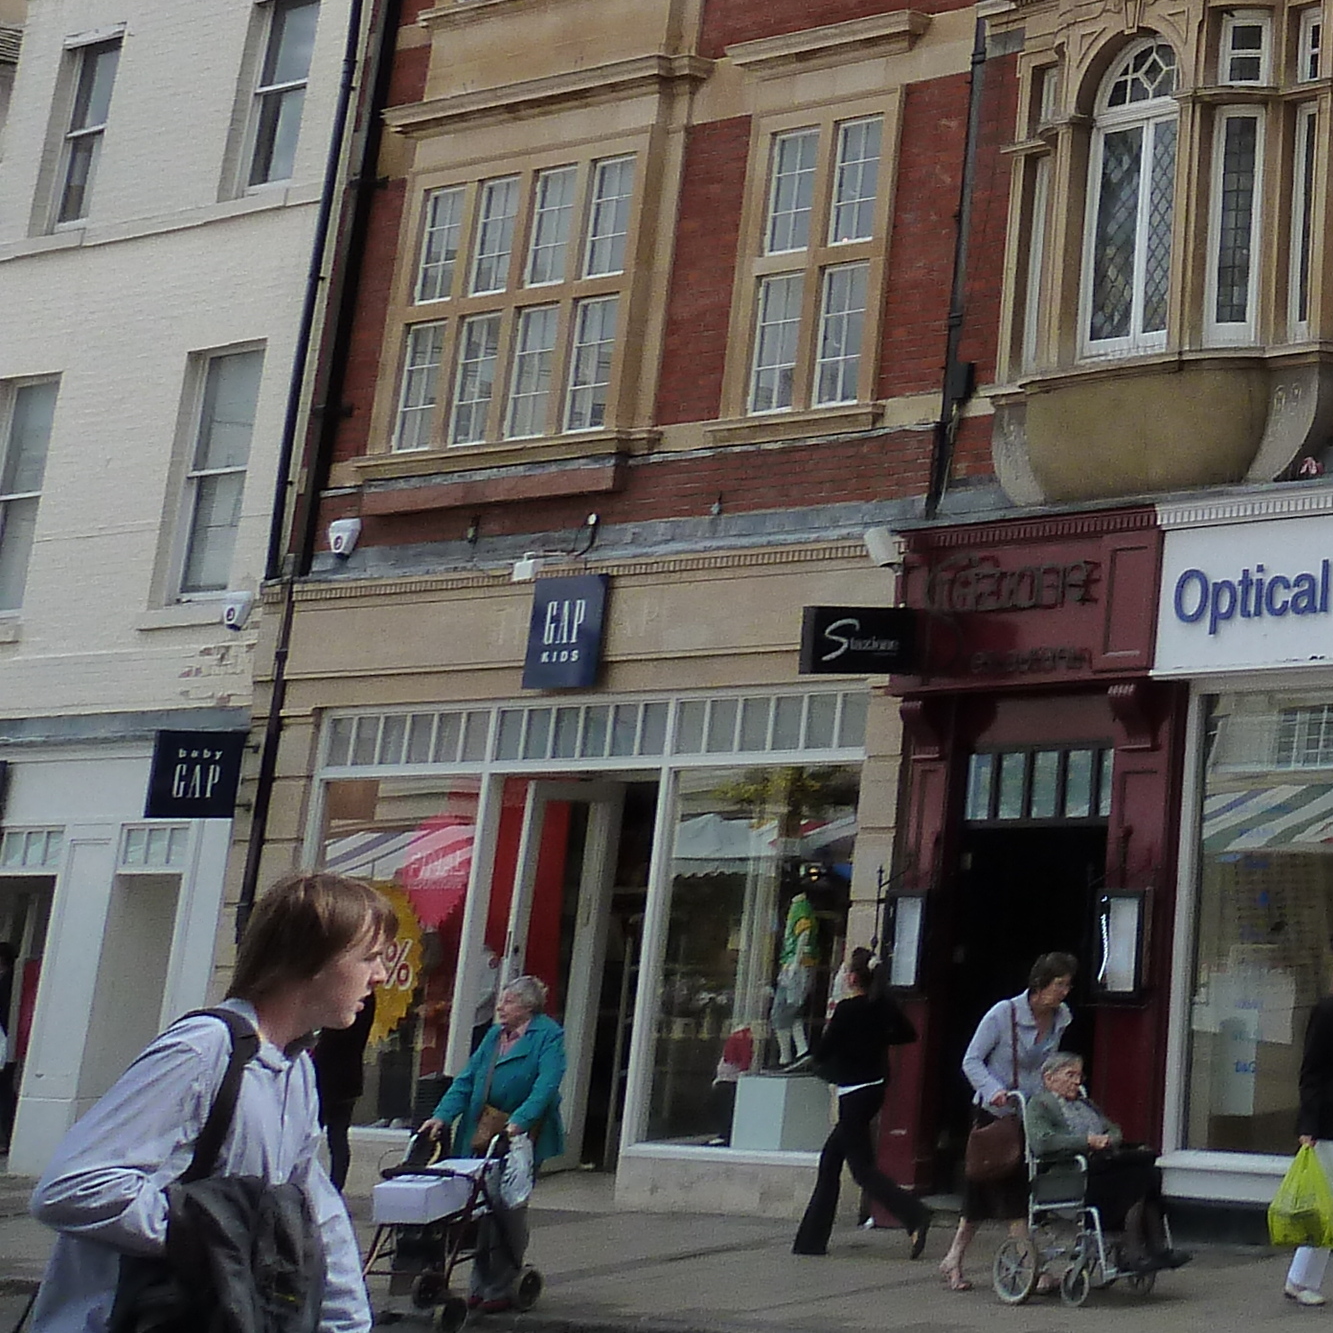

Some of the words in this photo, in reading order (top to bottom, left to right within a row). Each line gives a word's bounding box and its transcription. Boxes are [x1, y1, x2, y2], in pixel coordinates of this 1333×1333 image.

[1173, 558, 1331, 636] Optical
[543, 598, 586, 645] GAP
[540, 649, 579, 663] KIDS
[178, 748, 223, 760] baby
[171, 763, 221, 798] GAP
